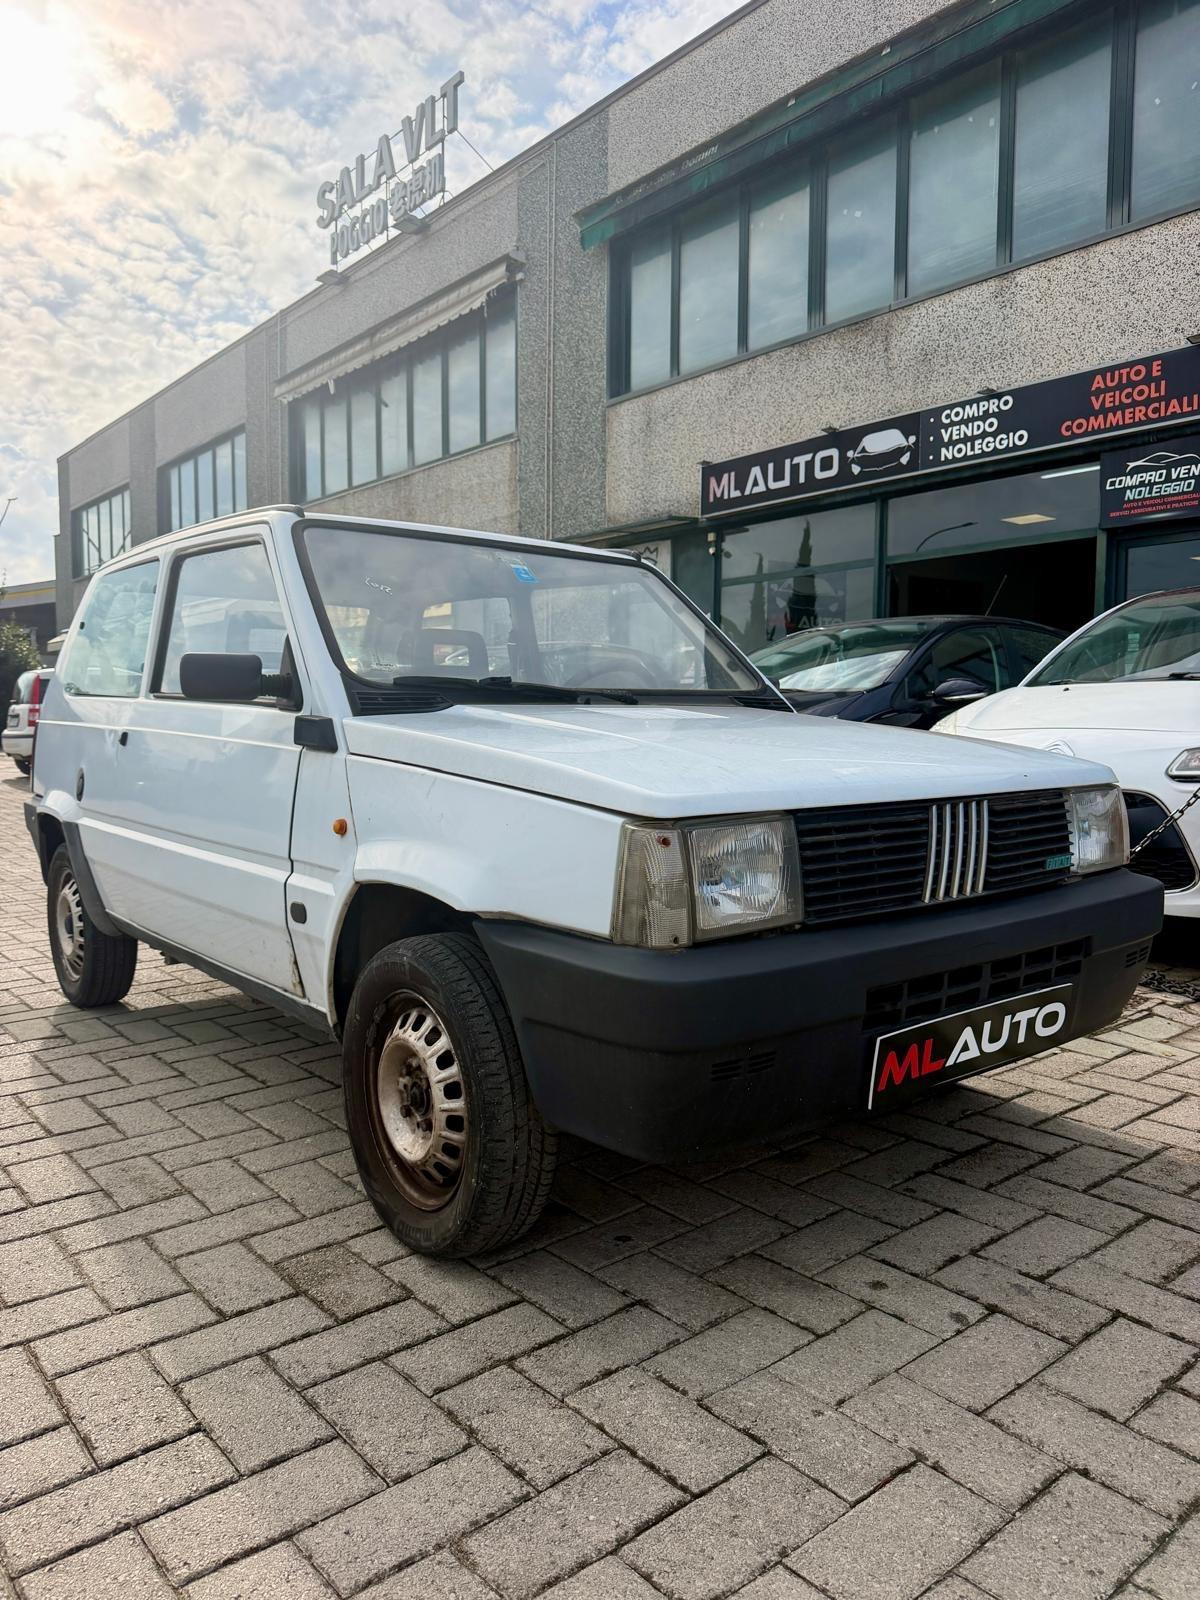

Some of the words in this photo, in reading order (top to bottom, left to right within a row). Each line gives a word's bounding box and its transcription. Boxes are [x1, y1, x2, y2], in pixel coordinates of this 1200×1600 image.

[316, 134, 396, 229] SALA
[401, 70, 465, 164] VLT
[330, 198, 389, 265] POGGIO
[1091, 364, 1147, 391] AUTO
[1152, 360, 1162, 377] E
[940, 395, 1014, 424] COMPRO
[1090, 380, 1166, 410] VEICOLI
[941, 417, 999, 443] VENDO
[1060, 394, 1199, 436] COMMERCIALI
[940, 429, 1029, 463] NOLEGGIO
[1106, 469, 1167, 490] COMPRO
[1125, 479, 1195, 501] NOLEGGIO
